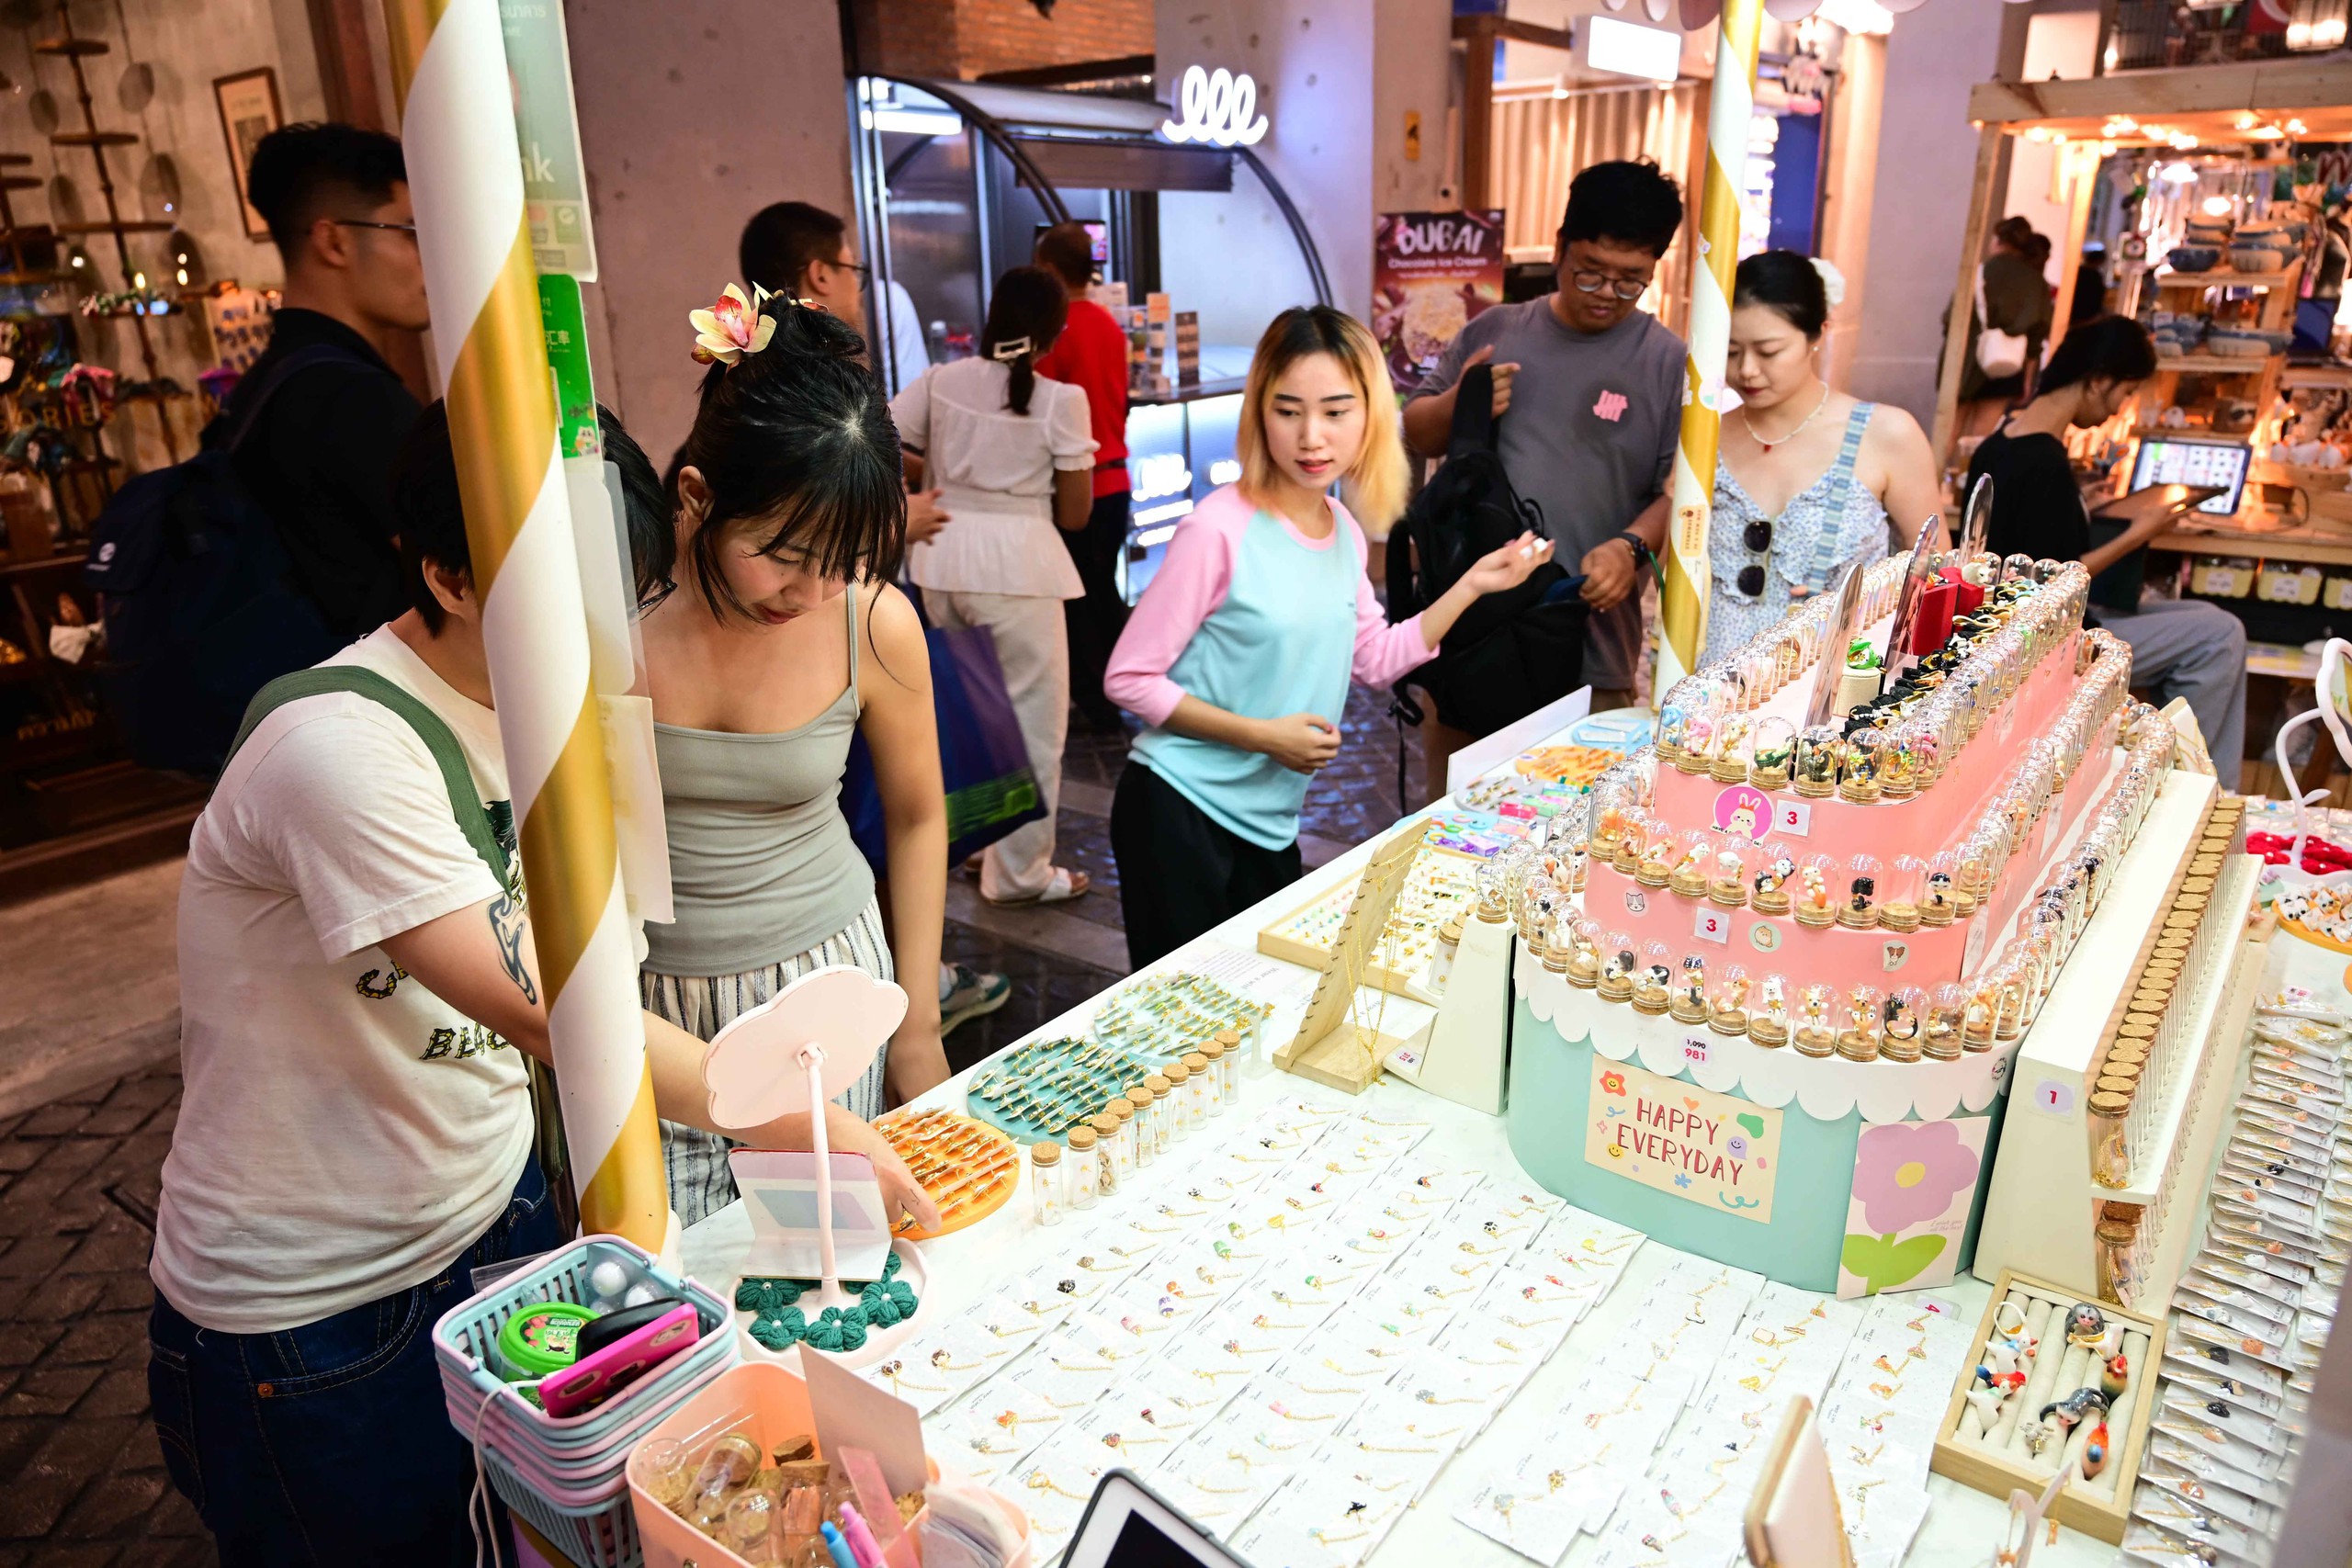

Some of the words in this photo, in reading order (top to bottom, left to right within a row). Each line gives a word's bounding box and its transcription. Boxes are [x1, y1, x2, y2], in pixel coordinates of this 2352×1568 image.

[1396, 220, 1485, 255] DUBAI
[1786, 810, 1798, 826] 3
[1706, 919, 1716, 932] 3
[1686, 1038, 1706, 1049] 1,090
[1685, 1048, 1705, 1061] 981
[2050, 1090, 2057, 1104] 1
[1636, 1097, 1718, 1145] HAPPY
[1617, 1122, 1743, 1186] EVERYDAY
[1925, 1303, 1940, 1313] 4
